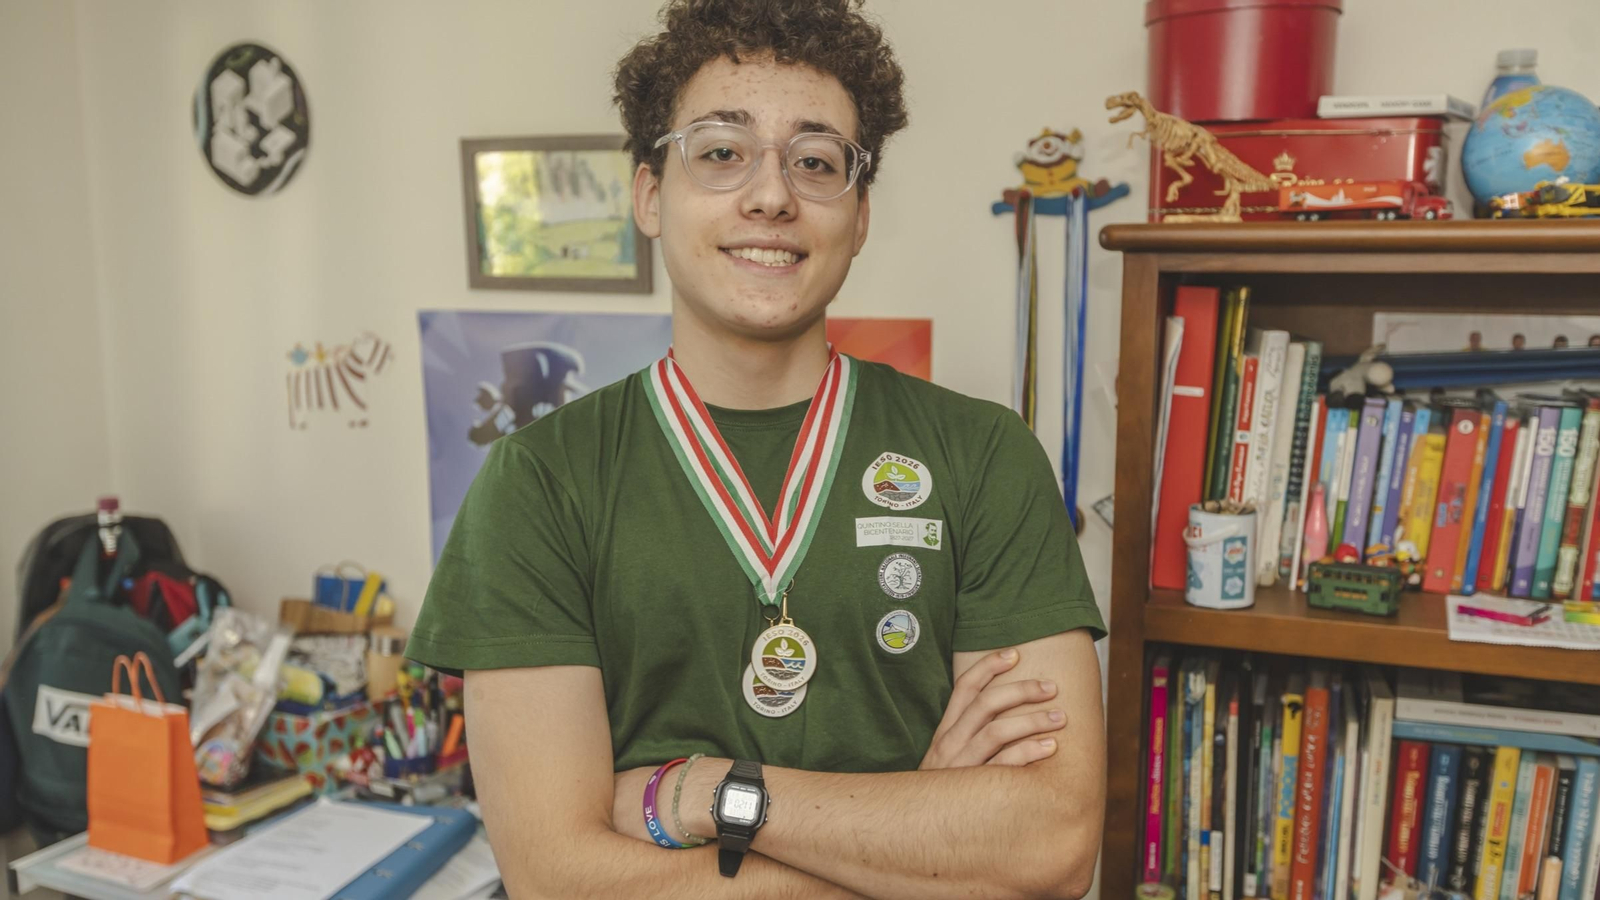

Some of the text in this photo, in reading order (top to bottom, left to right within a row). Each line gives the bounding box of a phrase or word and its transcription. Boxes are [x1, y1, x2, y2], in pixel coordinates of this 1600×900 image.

[1537, 426, 1557, 456] 150
[1556, 427, 1578, 457] 150
[871, 454, 920, 470] IESO 2026
[874, 495, 899, 508] TORINO
[905, 495, 923, 507] ITALY
[857, 521, 914, 529] QUINTINO SELLA
[863, 528, 914, 536] BICENTENARIO
[762, 629, 810, 646] IESO 2026
[760, 672, 783, 688] TORINO
[788, 676, 805, 688] ITALY
[45, 697, 90, 735] VA
[752, 701, 776, 715] TORINO
[781, 701, 798, 713] ITALY
[644, 805, 671, 848] IS LOVE
